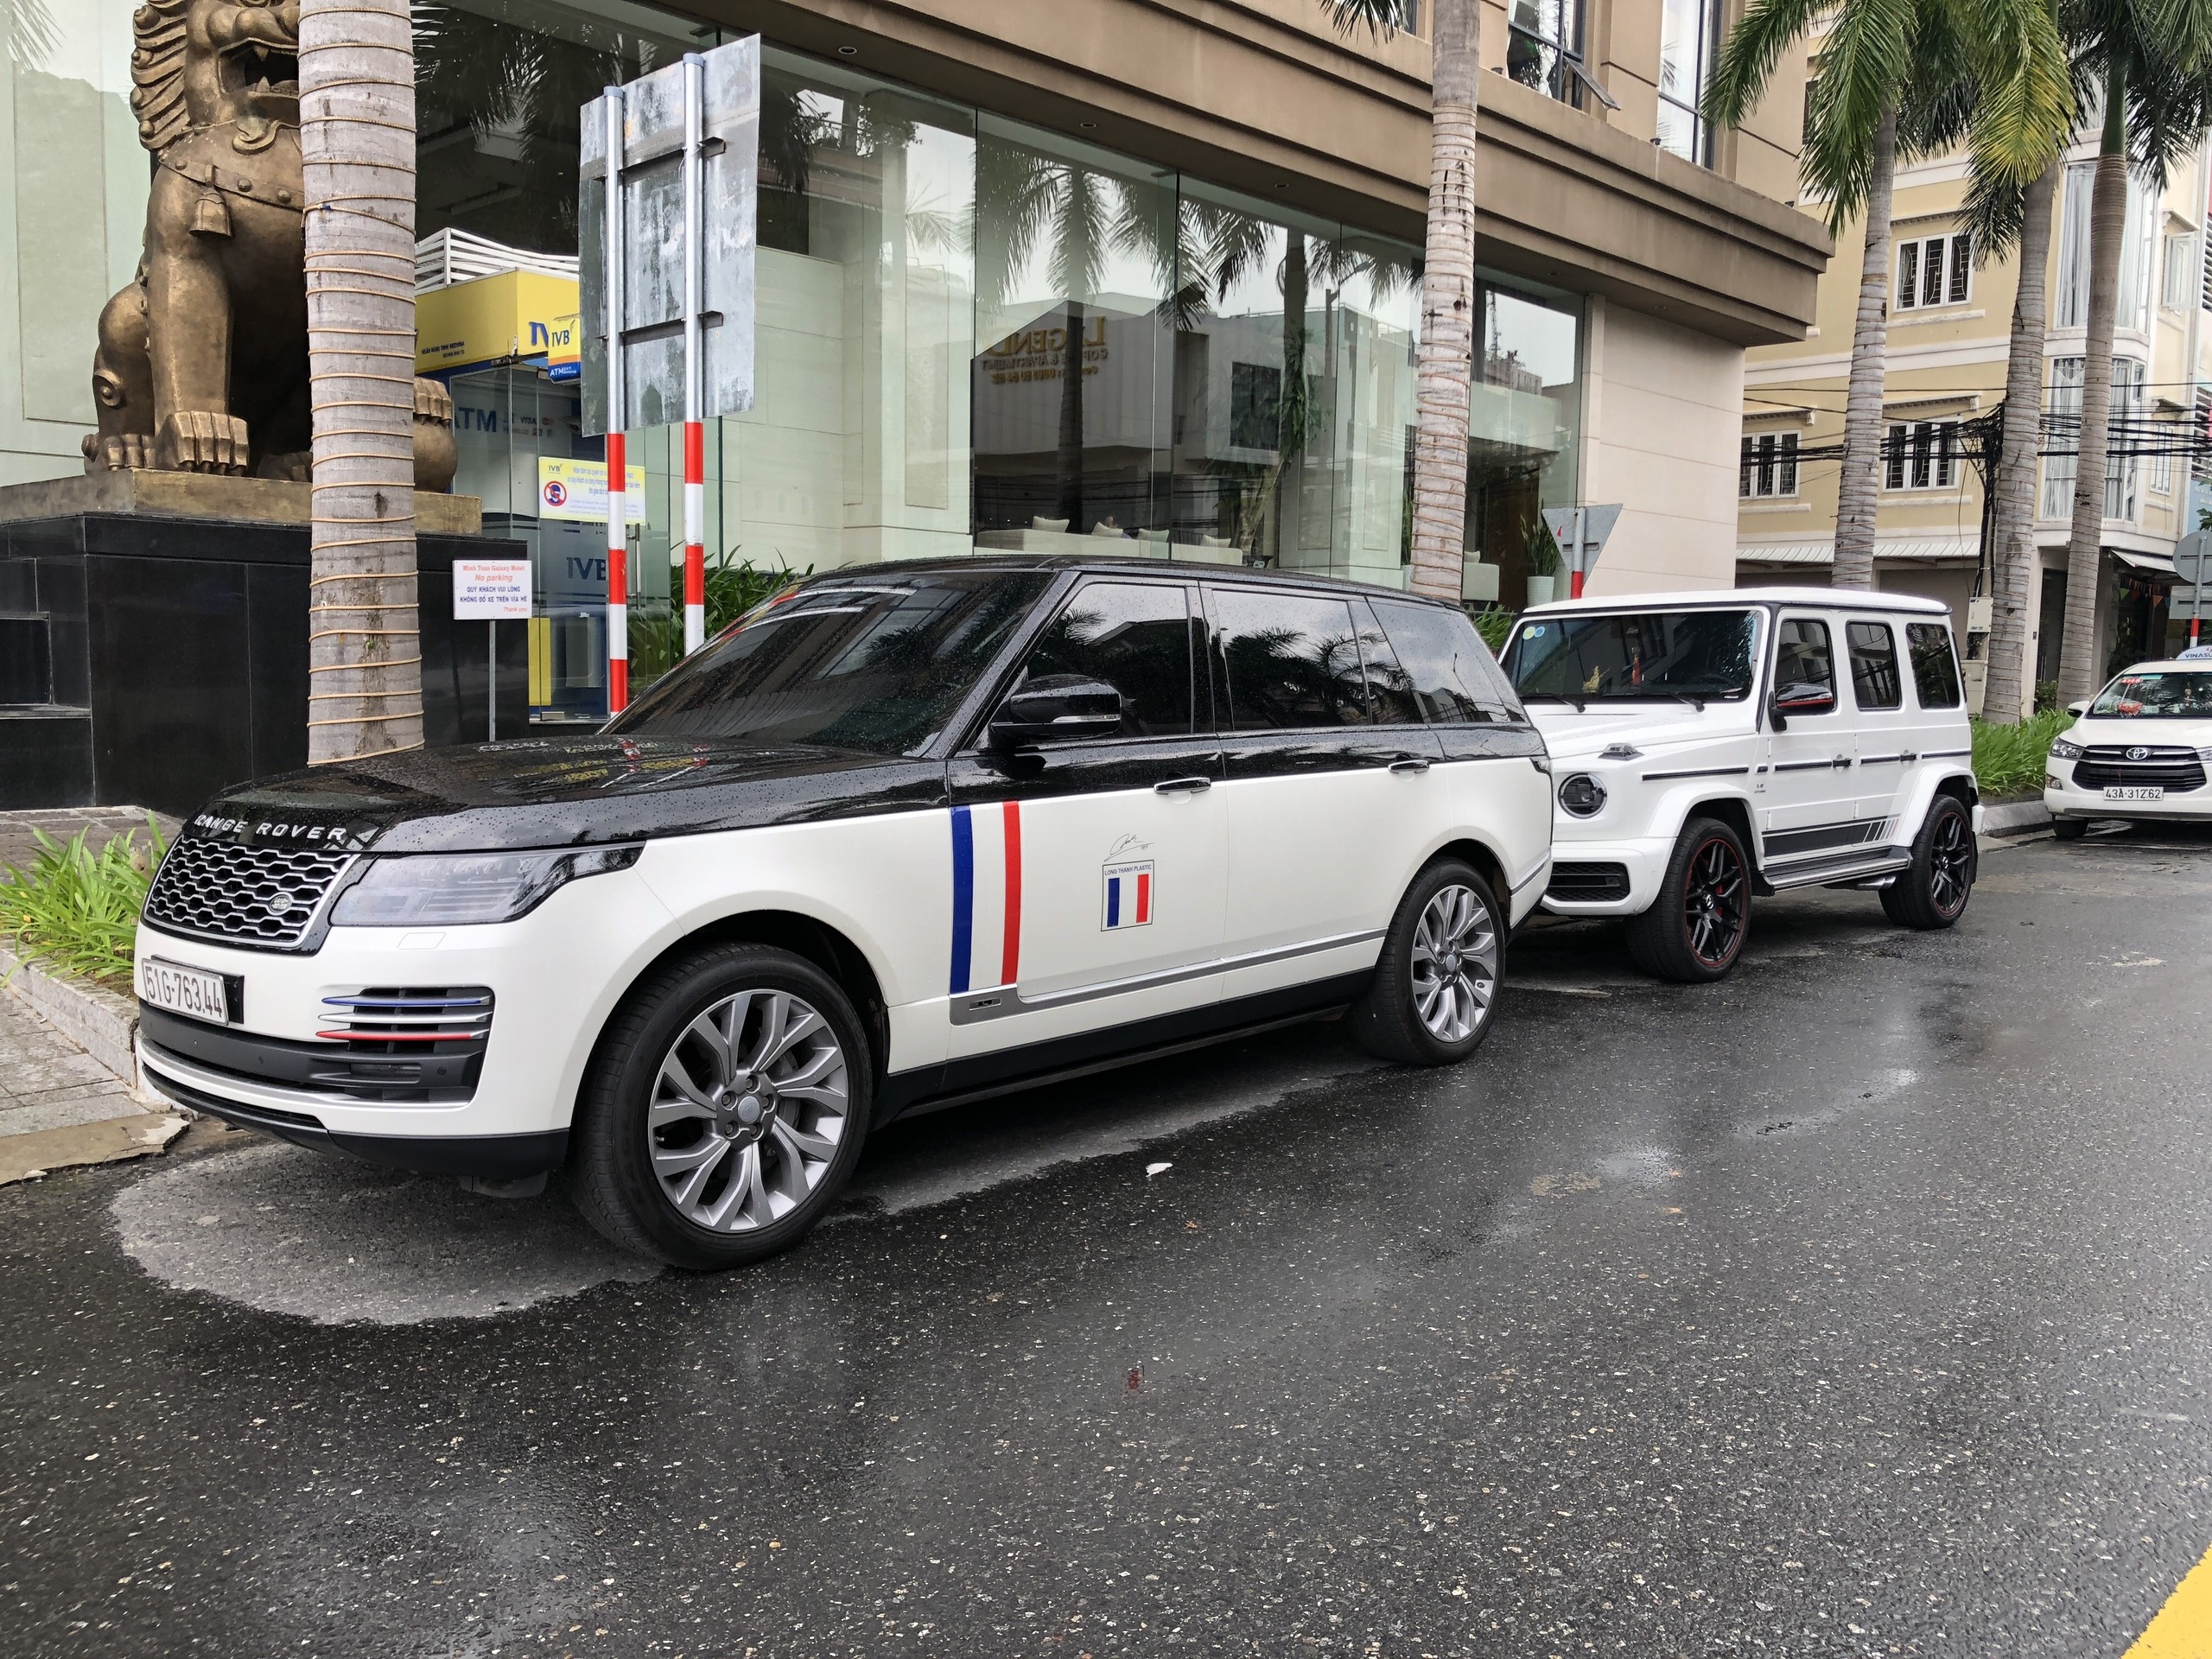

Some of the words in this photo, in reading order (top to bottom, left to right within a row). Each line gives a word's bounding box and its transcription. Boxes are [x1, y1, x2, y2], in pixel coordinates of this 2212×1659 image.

[551, 330, 570, 347] IVB
[550, 366, 565, 377] ATM
[520, 416, 537, 425] VISA
[486, 574, 513, 583] parking
[194, 814, 249, 835] RANGE
[256, 821, 347, 842] ROVER
[144, 965, 223, 1019] 51G-763.44
